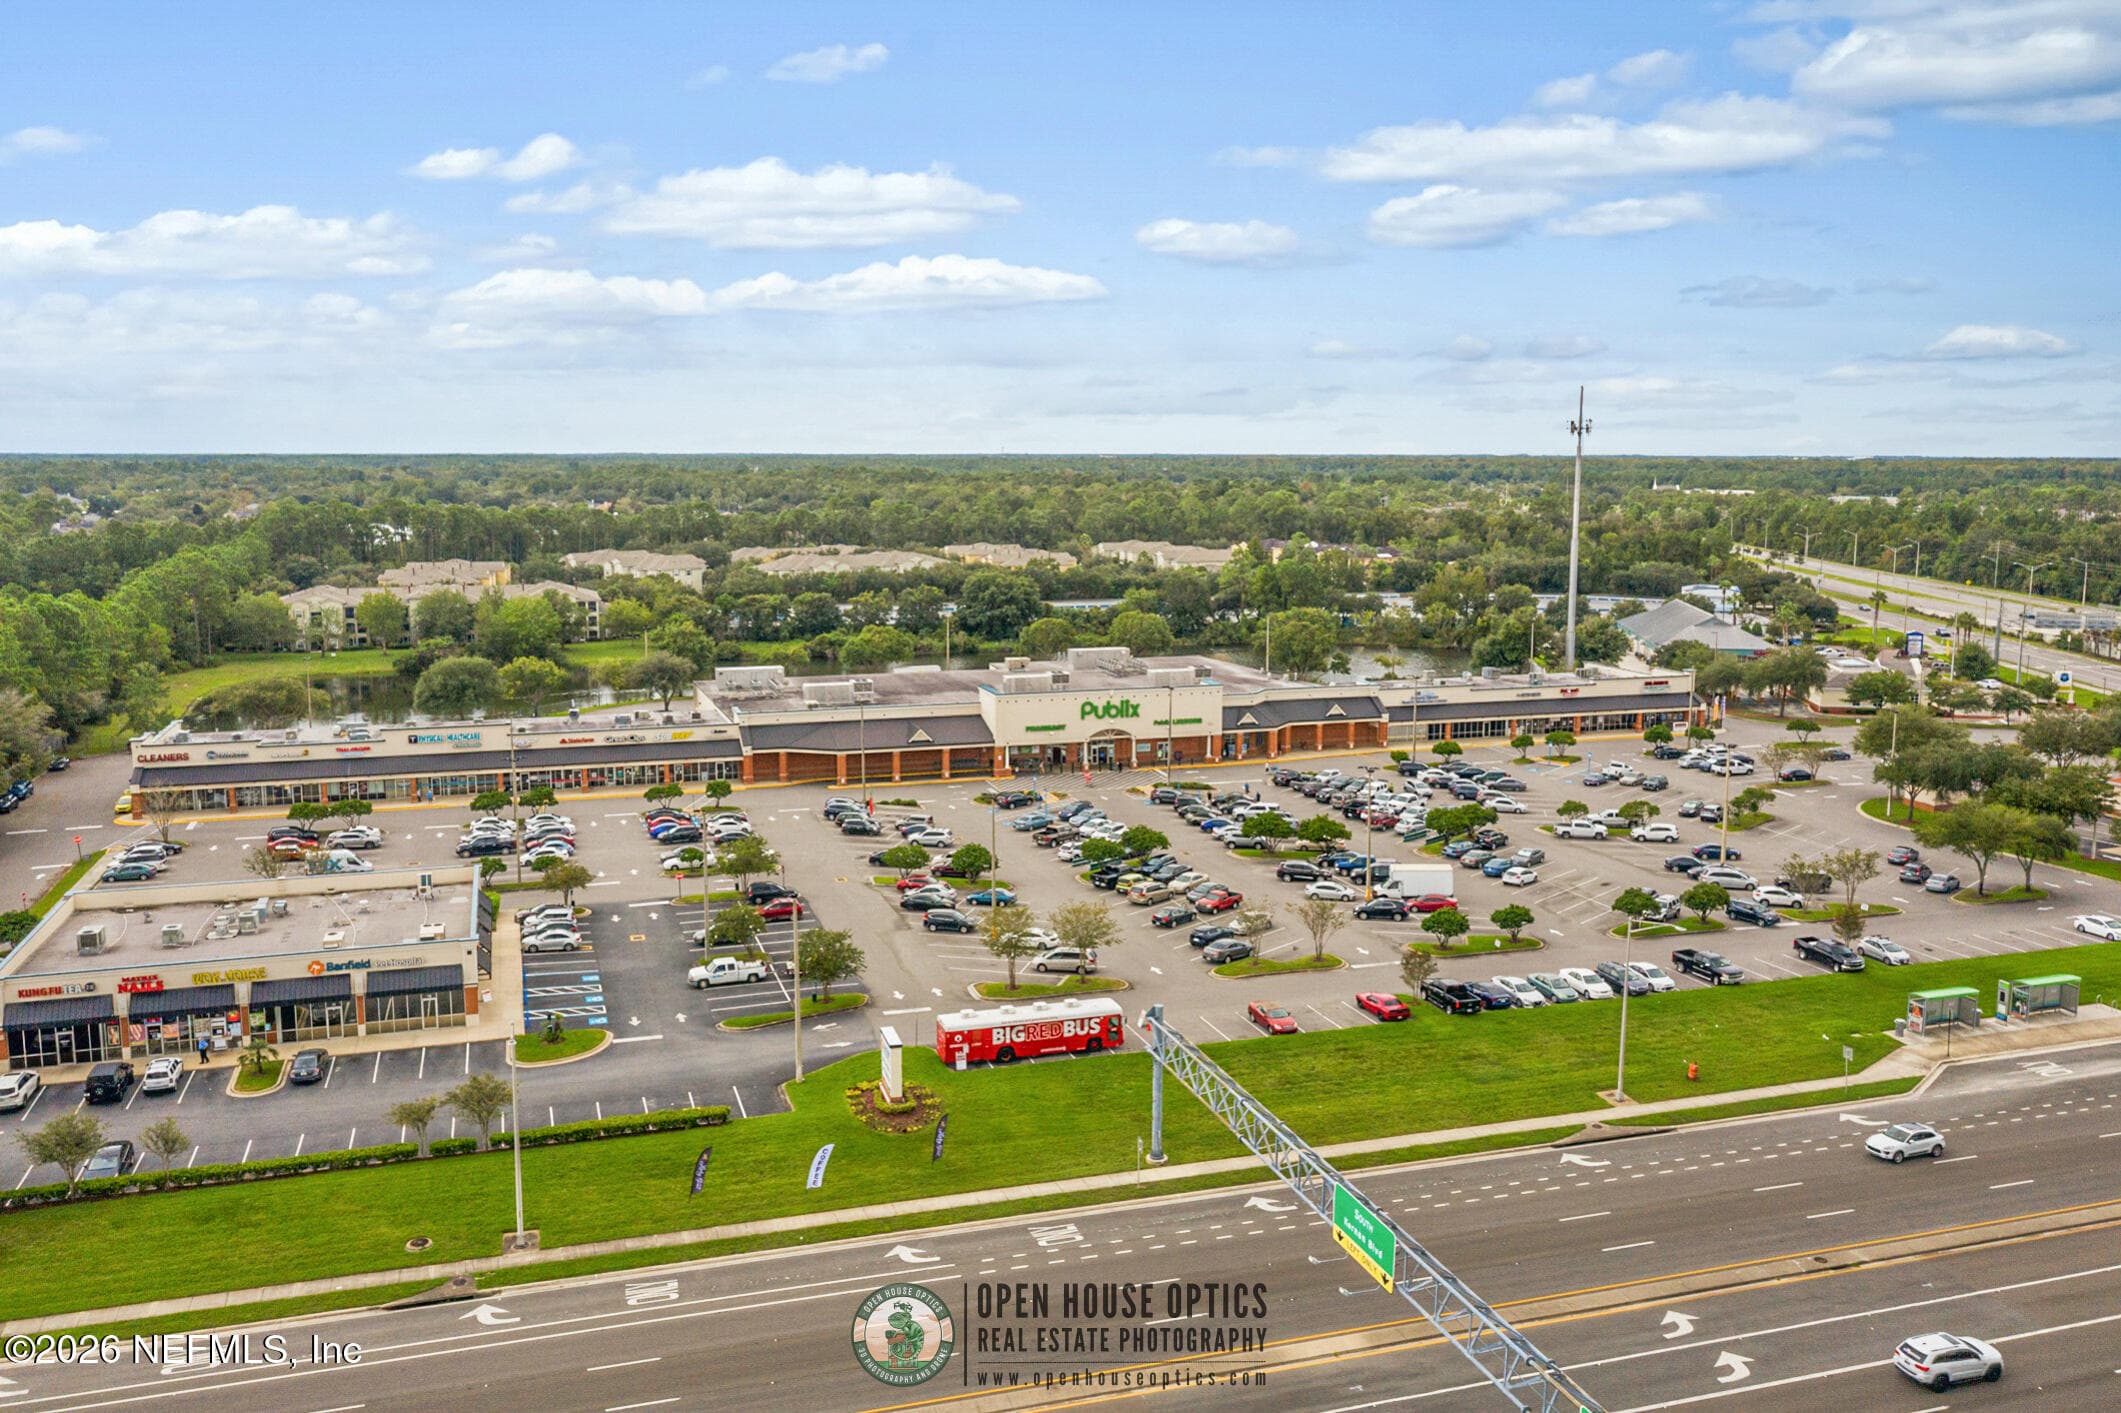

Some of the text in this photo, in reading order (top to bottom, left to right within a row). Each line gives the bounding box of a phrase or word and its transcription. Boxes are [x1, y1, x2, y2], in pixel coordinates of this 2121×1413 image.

[1080, 699, 1140, 720] Publix
[137, 753, 189, 763] CLEANERS
[326, 959, 371, 972] Banfield
[121, 974, 158, 983] MATRIX
[191, 966, 267, 985] WOK HOUSE
[18, 987, 43, 998] KUNG
[49, 986, 62, 995] FU
[63, 984, 82, 994] TEA
[117, 980, 164, 994] NAILS
[812, 1148, 829, 1187] COFFEE
